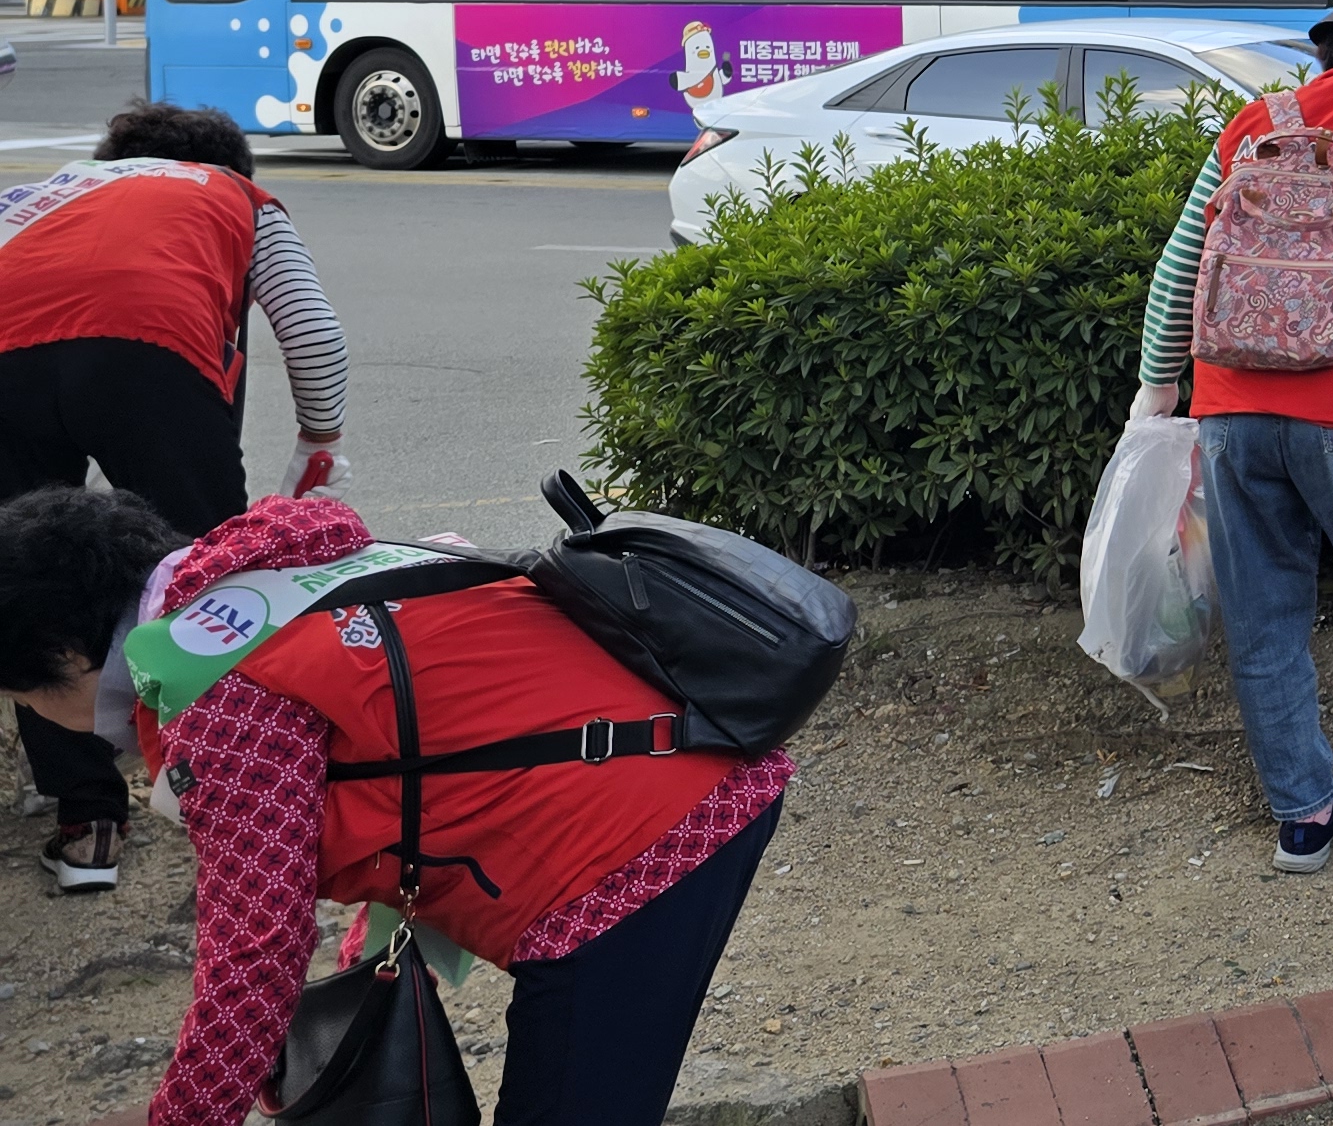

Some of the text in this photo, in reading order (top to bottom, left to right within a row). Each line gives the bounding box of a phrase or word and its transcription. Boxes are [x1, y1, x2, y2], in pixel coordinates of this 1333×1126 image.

[470, 43, 500, 64] 타면
[505, 40, 541, 63] 탈수록
[739, 40, 823, 61] 대중교통과
[494, 58, 623, 86] 타면 탈수록 절약하는
[741, 64, 791, 84] 모두가
